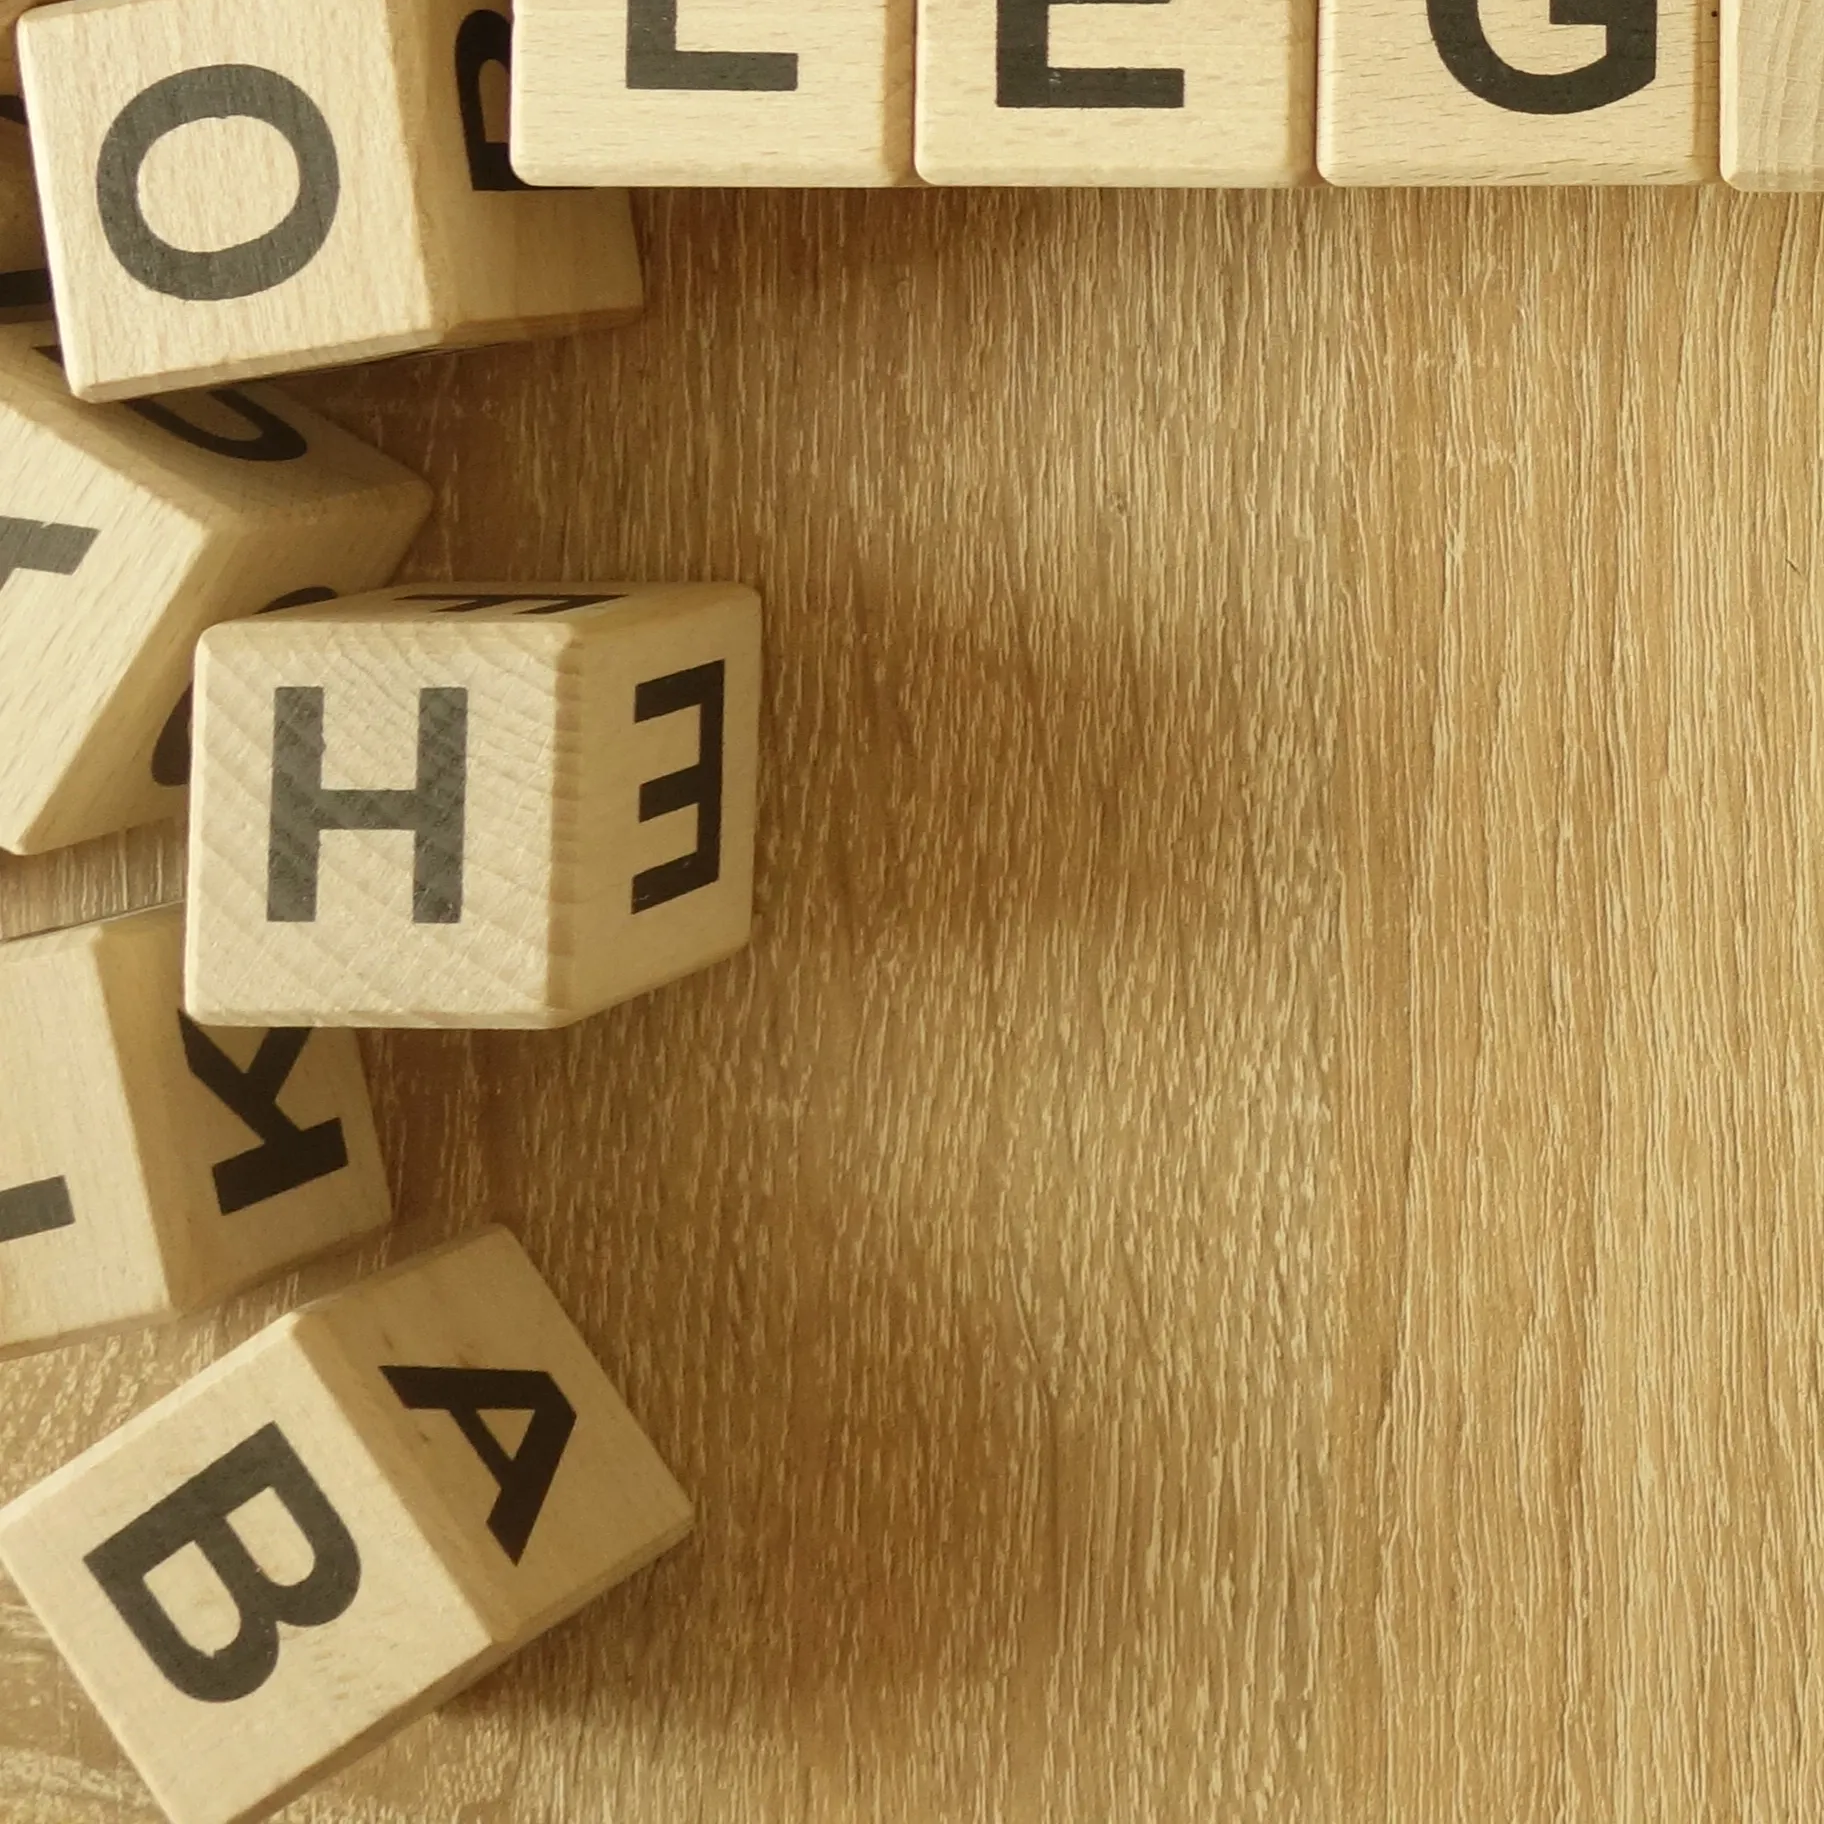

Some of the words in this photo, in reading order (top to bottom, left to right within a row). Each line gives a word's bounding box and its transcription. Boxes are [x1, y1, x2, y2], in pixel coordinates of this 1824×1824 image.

[97, 63, 340, 301] O
[266, 686, 468, 924] H
[631, 659, 726, 916] E
[178, 1008, 349, 1216] K
[82, 1420, 362, 1703] B
[377, 1363, 578, 1567] A
